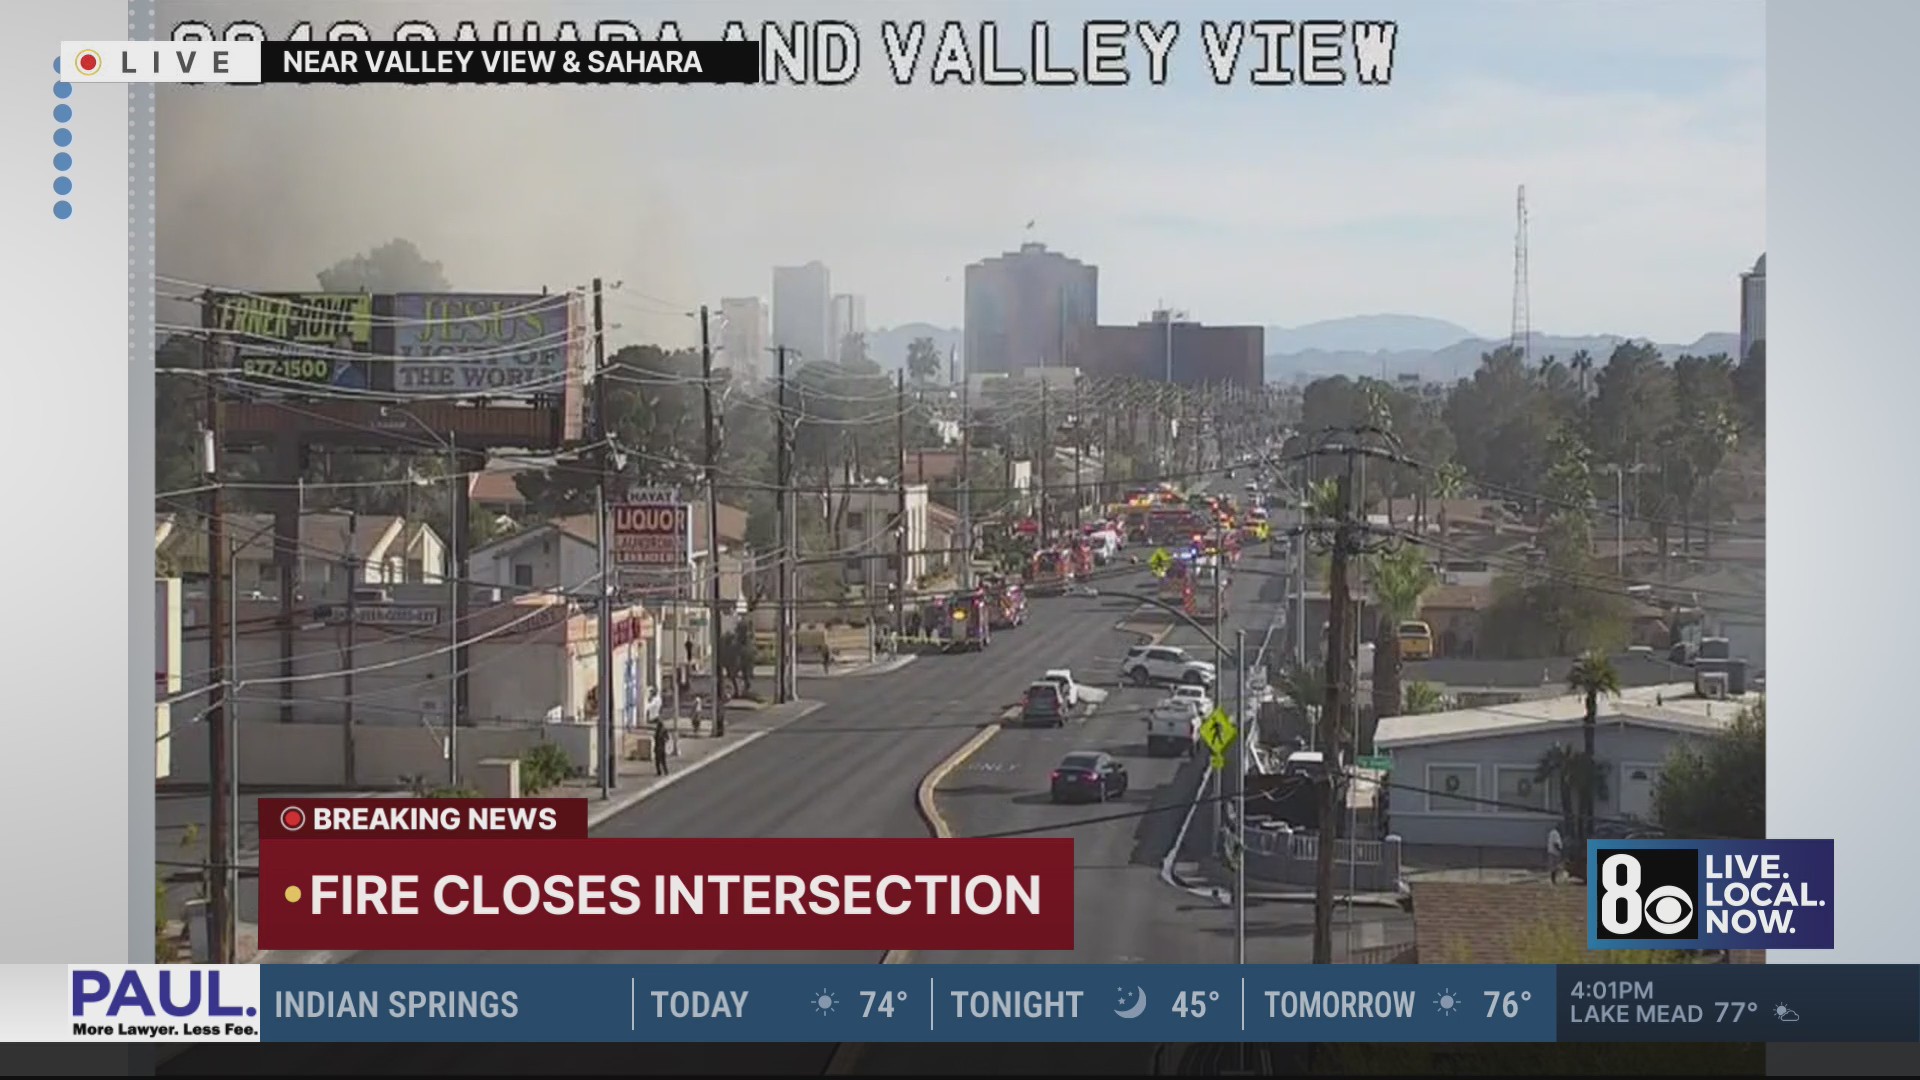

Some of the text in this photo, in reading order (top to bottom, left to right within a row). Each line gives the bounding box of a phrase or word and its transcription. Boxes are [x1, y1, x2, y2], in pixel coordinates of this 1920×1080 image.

[419, 300, 545, 343] JESUS
[243, 358, 328, 378] 877-1500
[400, 367, 455, 386] THE
[616, 508, 685, 531] LIQUOR
